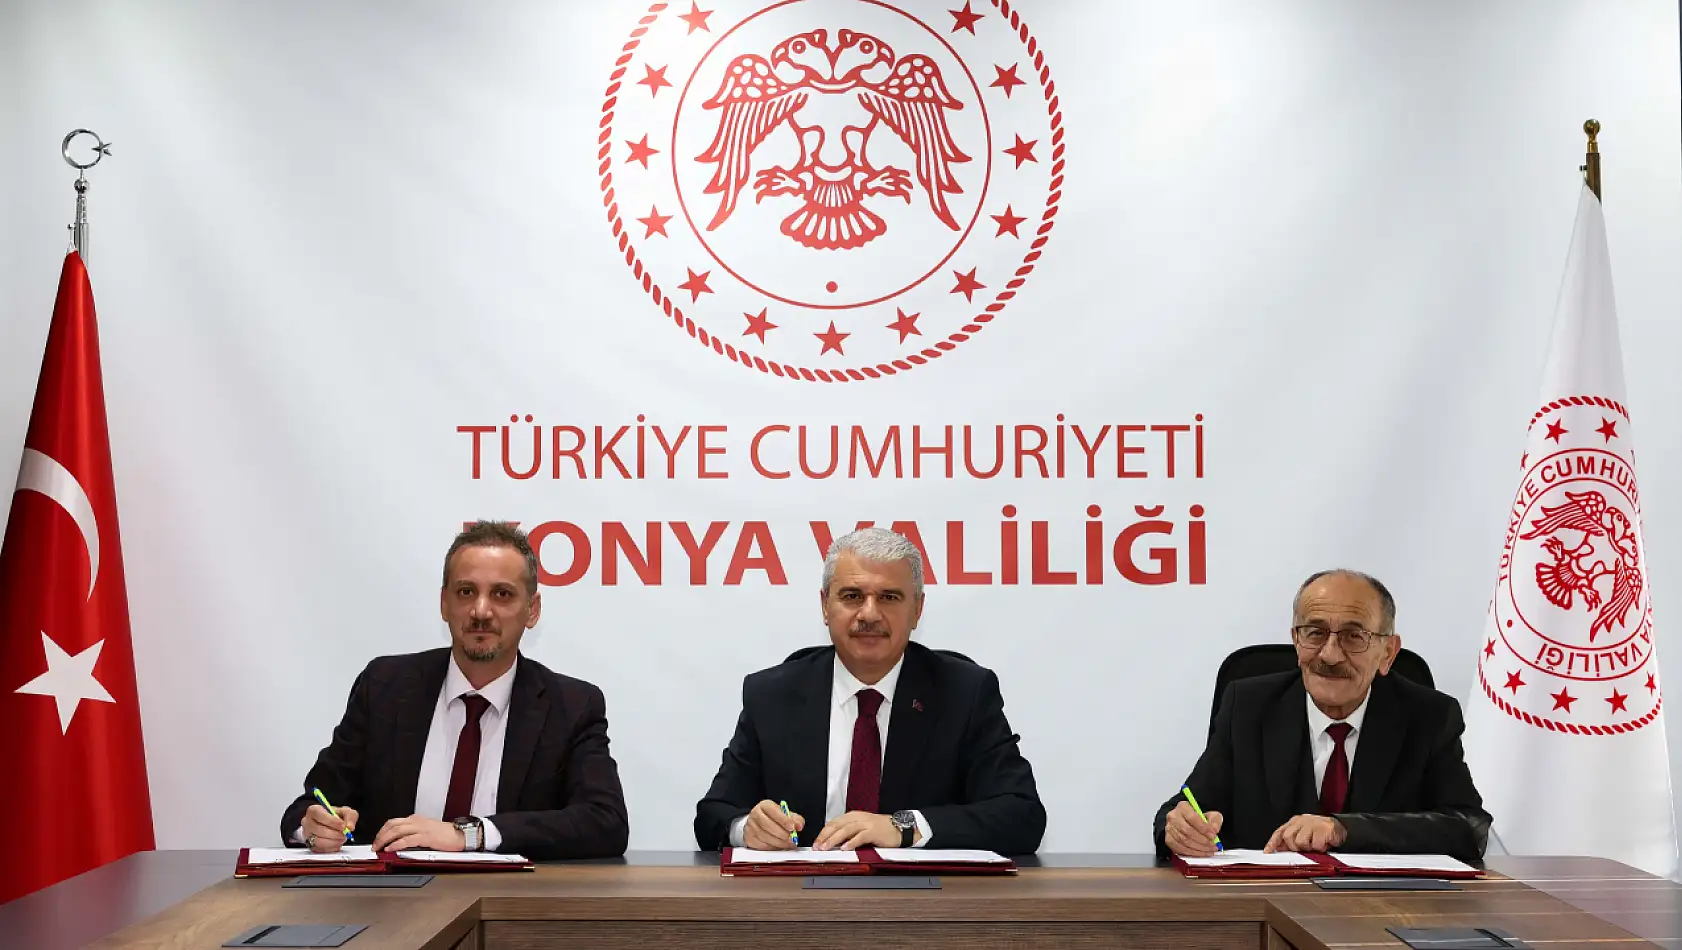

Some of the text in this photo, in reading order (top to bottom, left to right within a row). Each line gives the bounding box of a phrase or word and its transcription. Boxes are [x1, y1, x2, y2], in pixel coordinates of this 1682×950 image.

[457, 413, 1205, 480] TÜRKİYE CUMHURİYETİ
[462, 520, 789, 587] ONYA
[1535, 642, 1643, 677] VALİLİĞİ
